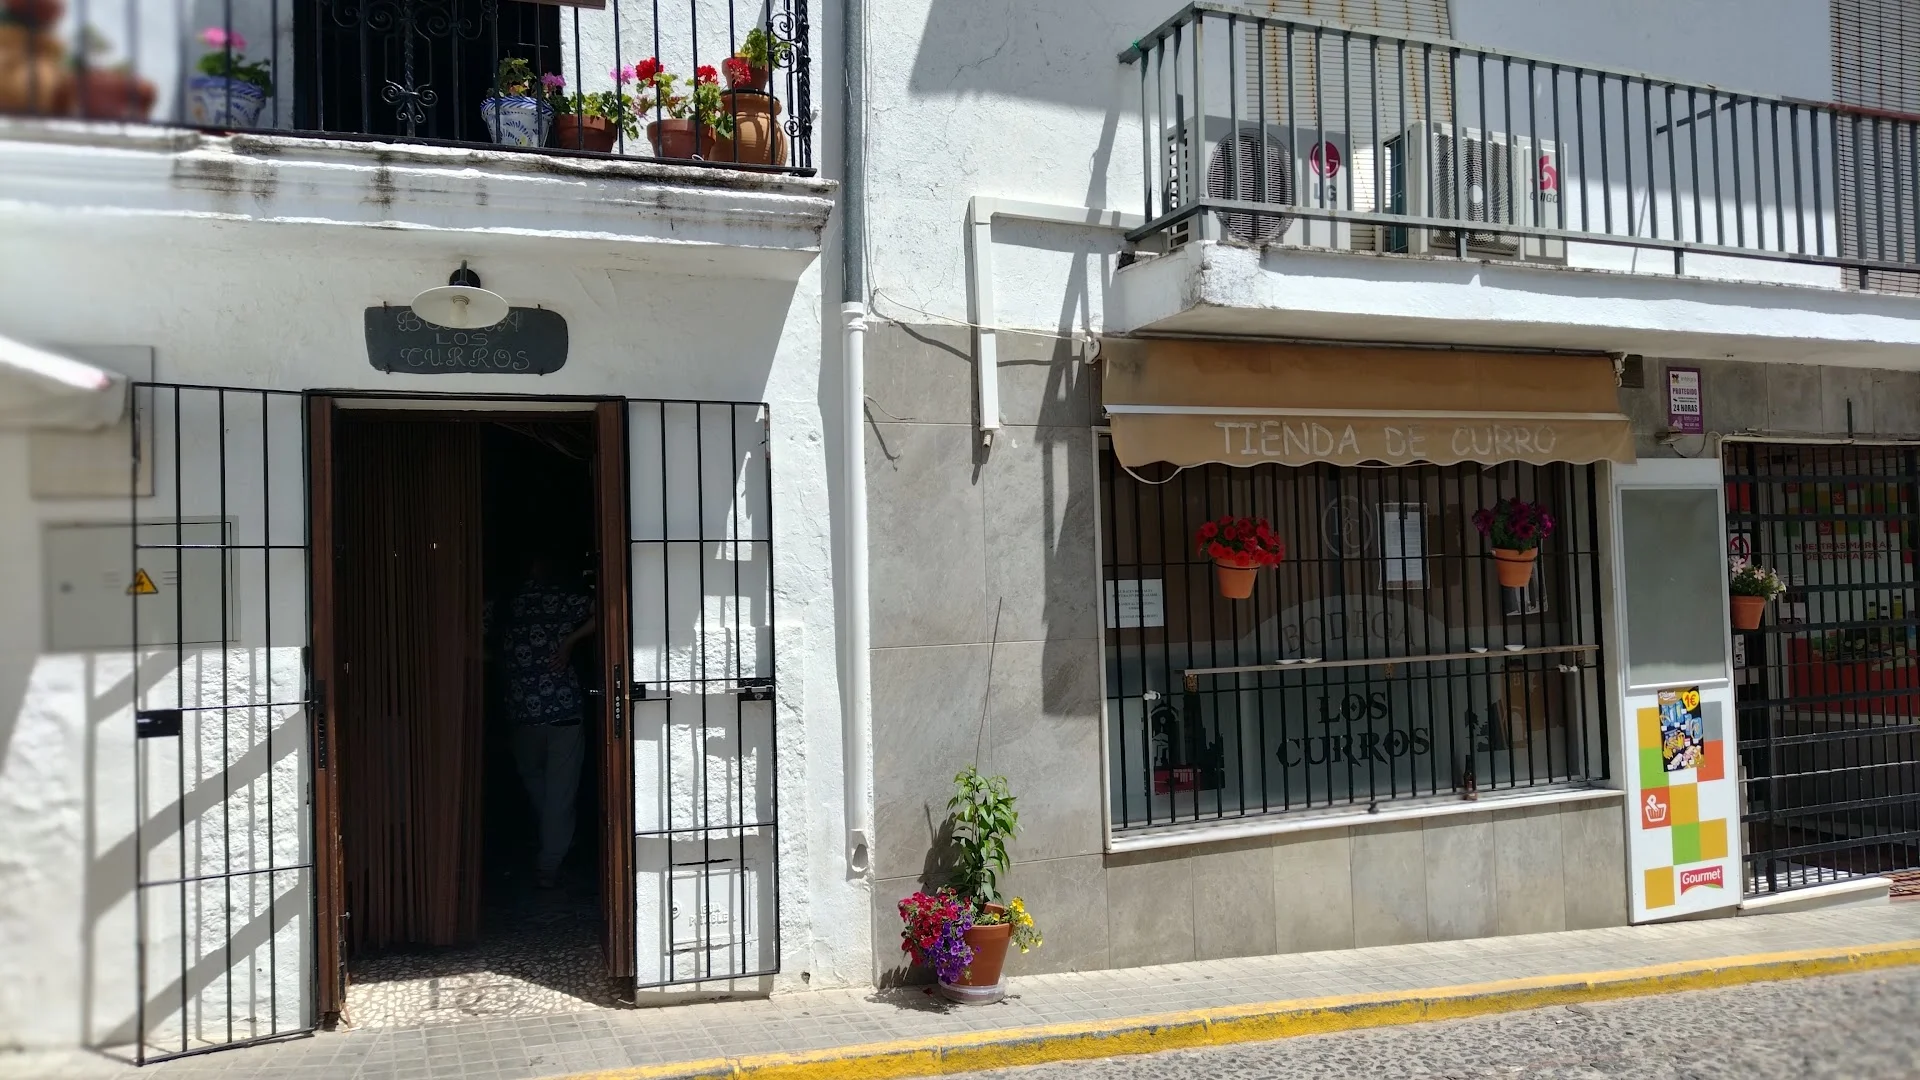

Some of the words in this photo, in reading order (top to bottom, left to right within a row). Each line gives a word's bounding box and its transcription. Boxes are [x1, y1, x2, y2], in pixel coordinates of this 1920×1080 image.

[1313, 182, 1337, 202] LG
[434, 332, 489, 346] LOS
[400, 347, 530, 371] CURROS
[1672, 387, 1698, 396] PROTEGIDO
[1672, 404, 1680, 412] 24
[1681, 404, 1698, 412] HORAS
[1214, 420, 1361, 457] TIENDA
[1383, 423, 1428, 458] DE
[1451, 422, 1558, 457] CURRO
[1821, 551, 1882, 561] CONFANZA
[1282, 609, 1416, 654] BODEGA
[1317, 691, 1388, 724] LOS
[1684, 694, 1697, 708] 1€
[1275, 727, 1430, 768] CURROS
[1682, 868, 1721, 885] Gourmet
